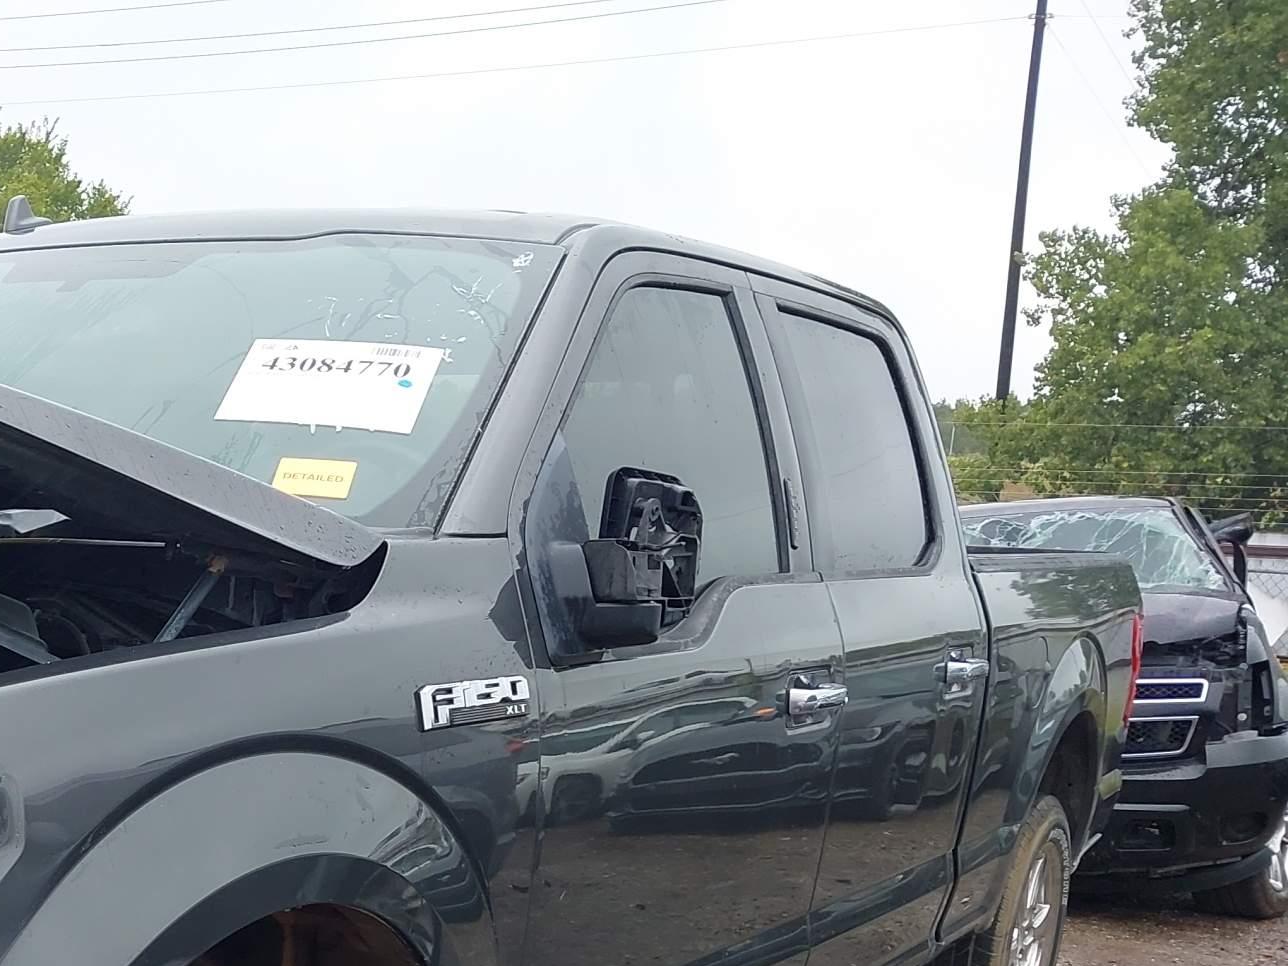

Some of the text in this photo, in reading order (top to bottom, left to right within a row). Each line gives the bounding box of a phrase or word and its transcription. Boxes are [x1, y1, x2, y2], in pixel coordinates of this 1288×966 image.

[261, 356, 411, 378] 43084770
[282, 471, 344, 483] DETAILED
[505, 703, 528, 715] XLT
